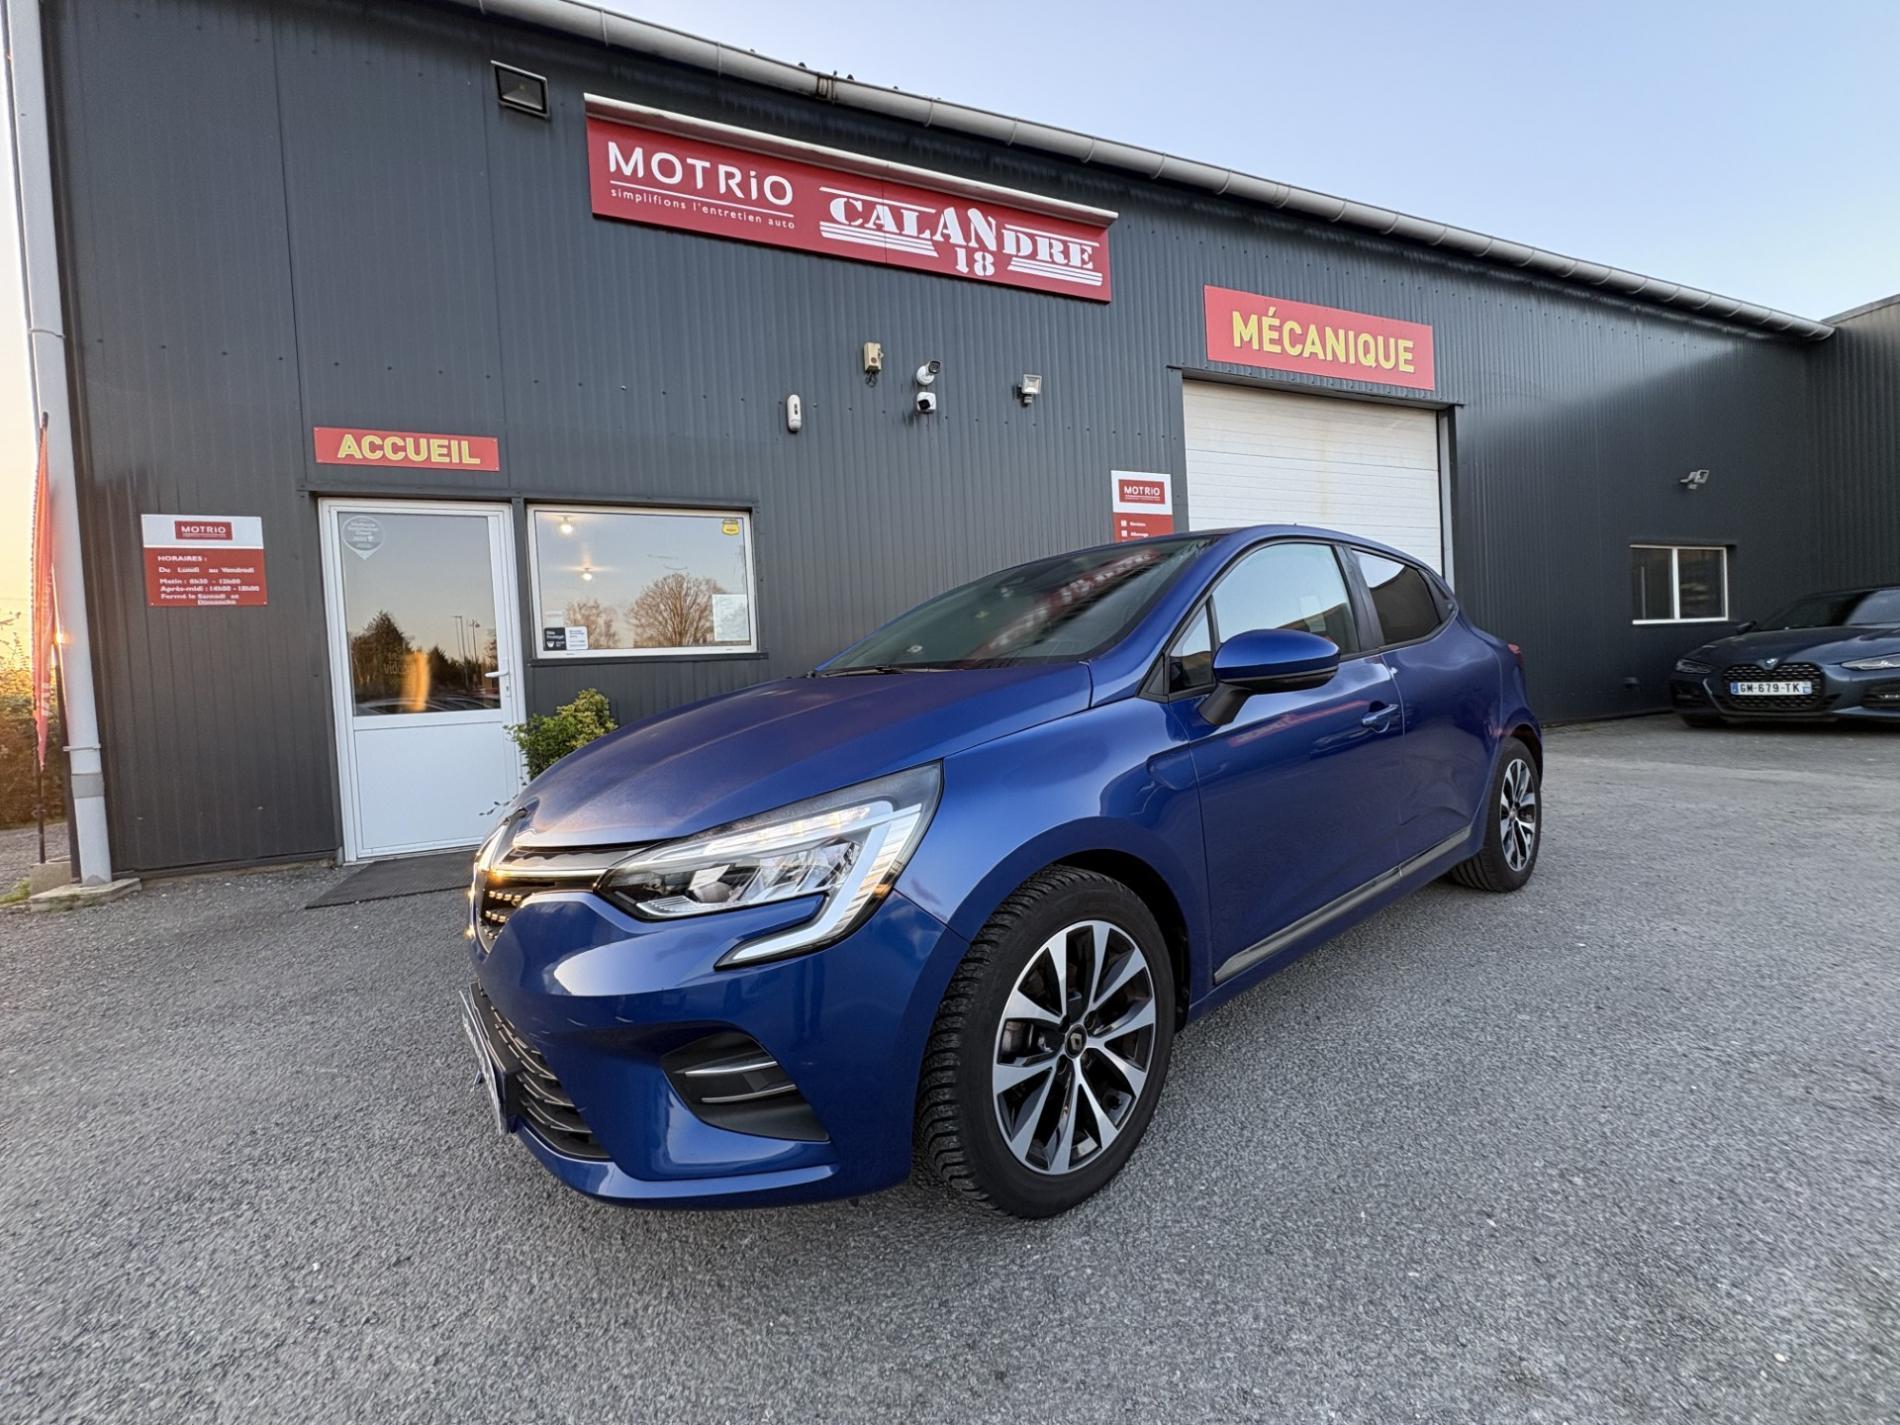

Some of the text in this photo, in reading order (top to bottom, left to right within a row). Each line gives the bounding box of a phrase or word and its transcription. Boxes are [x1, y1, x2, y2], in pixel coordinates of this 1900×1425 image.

[610, 188, 795, 230] simplifions l'entretien auto
[829, 197, 1094, 270] CALANDRE
[954, 247, 996, 277] 18
[1231, 306, 1416, 373] MÉCANIQUE
[337, 434, 481, 465] ACCUEIL
